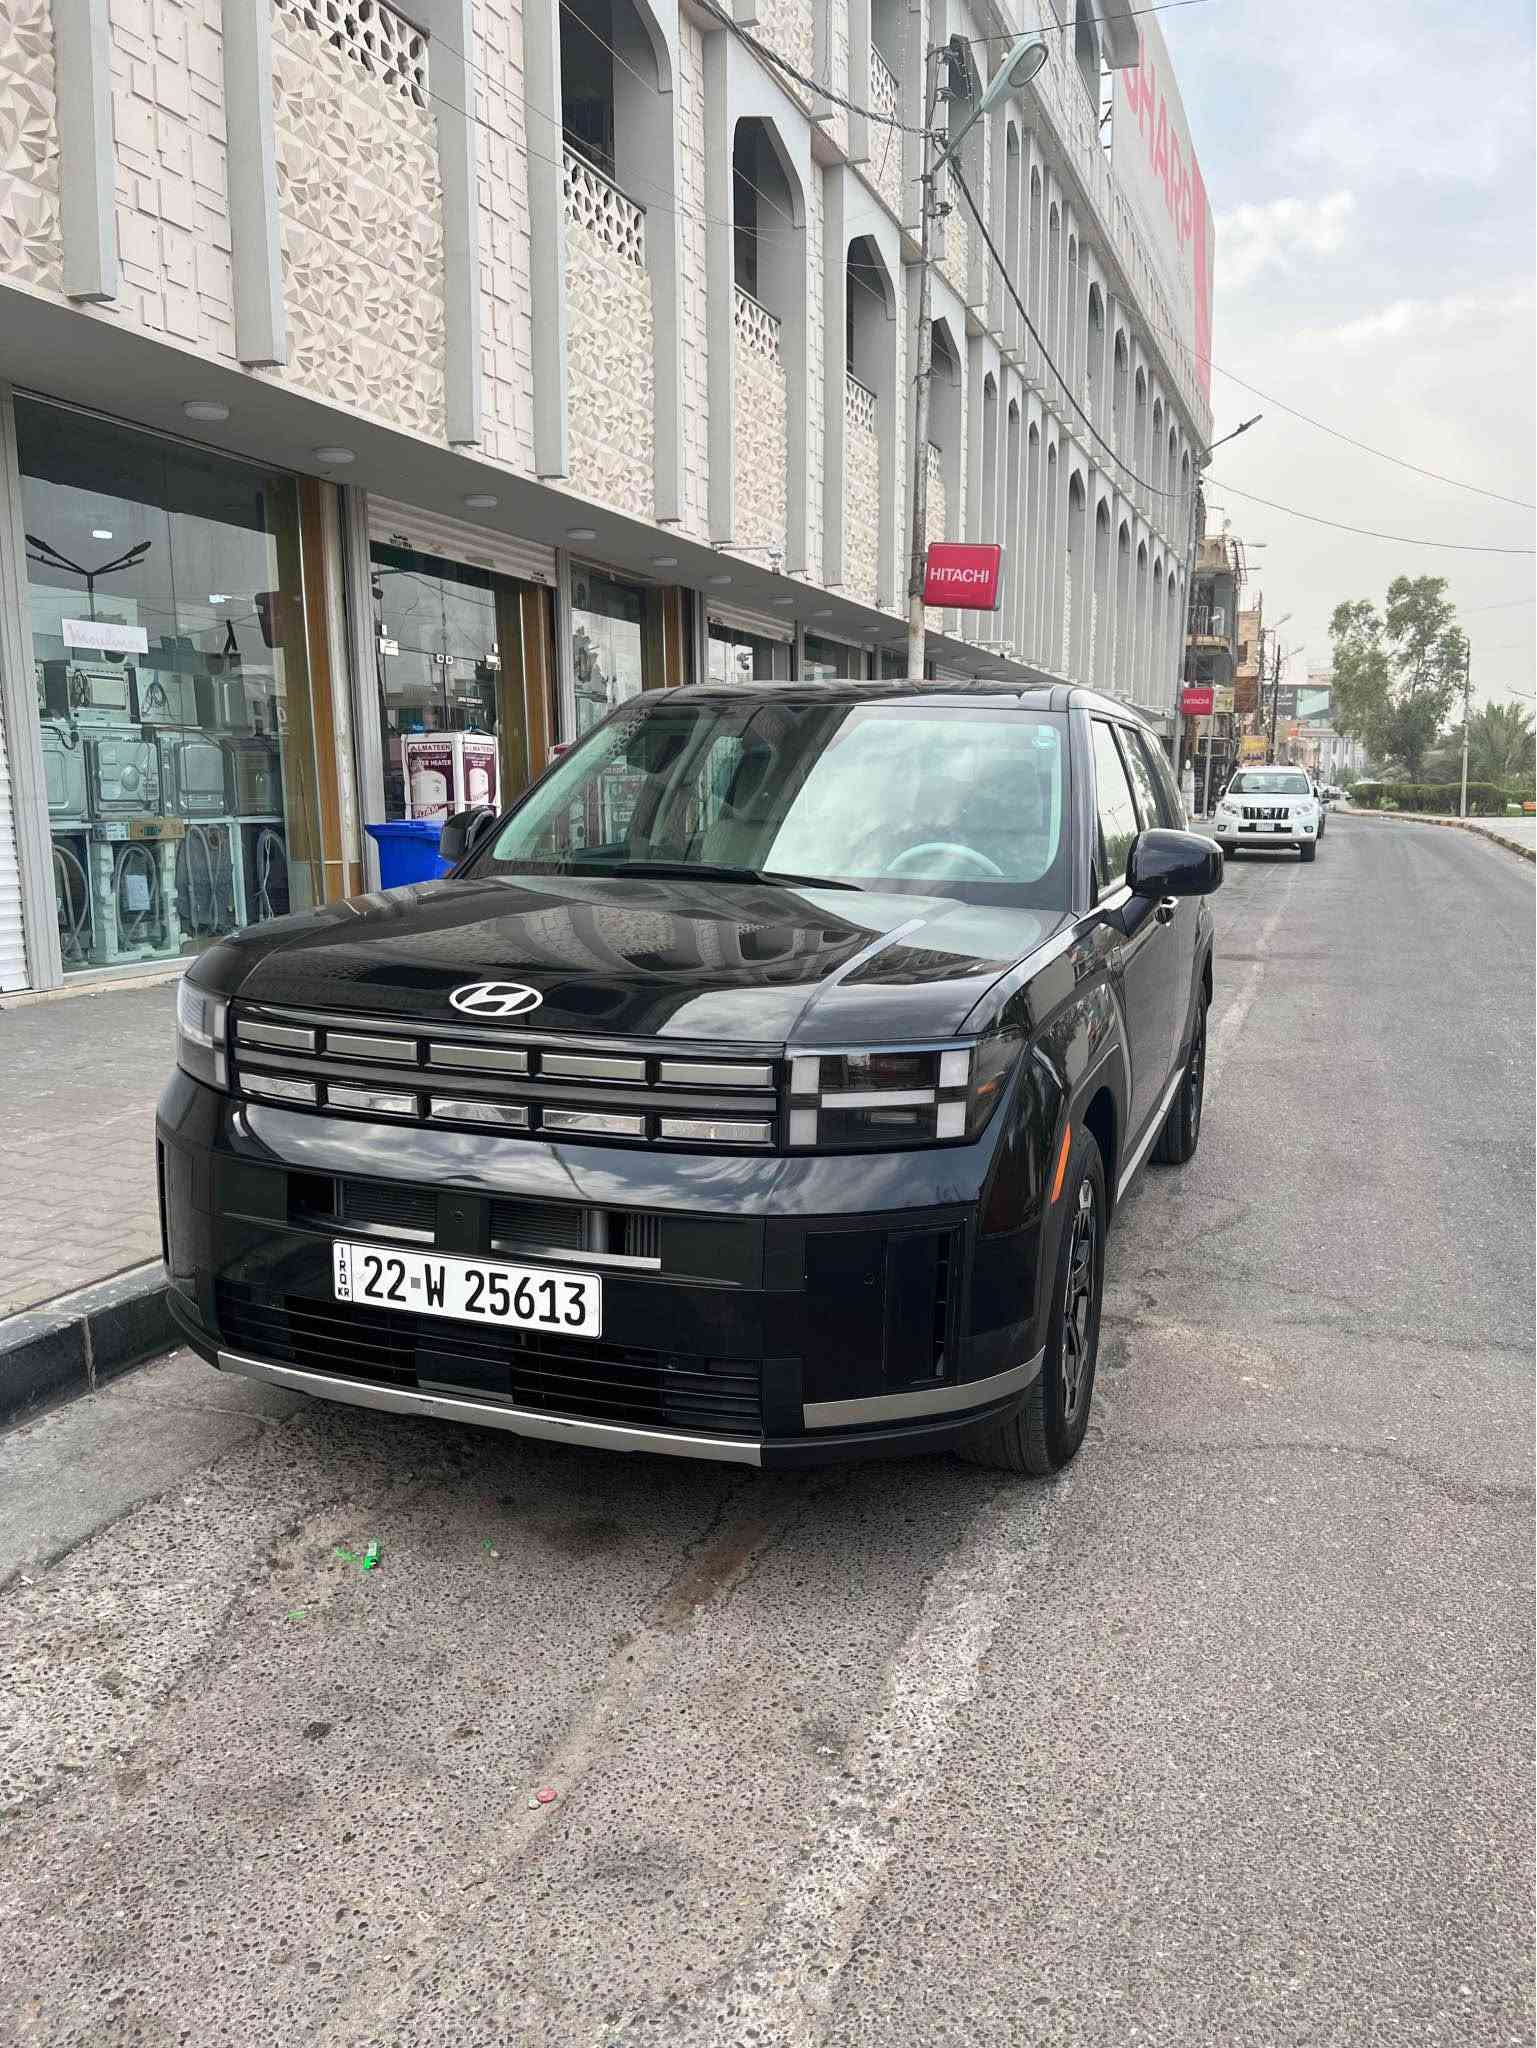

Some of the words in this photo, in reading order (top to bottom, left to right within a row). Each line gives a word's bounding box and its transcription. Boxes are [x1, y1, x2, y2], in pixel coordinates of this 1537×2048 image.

[930, 567, 990, 584] HITACHI
[337, 1287, 350, 1297] KR
[364, 1255, 407, 1302] 22
[424, 1263, 446, 1308] W
[464, 1269, 586, 1327] 25613
